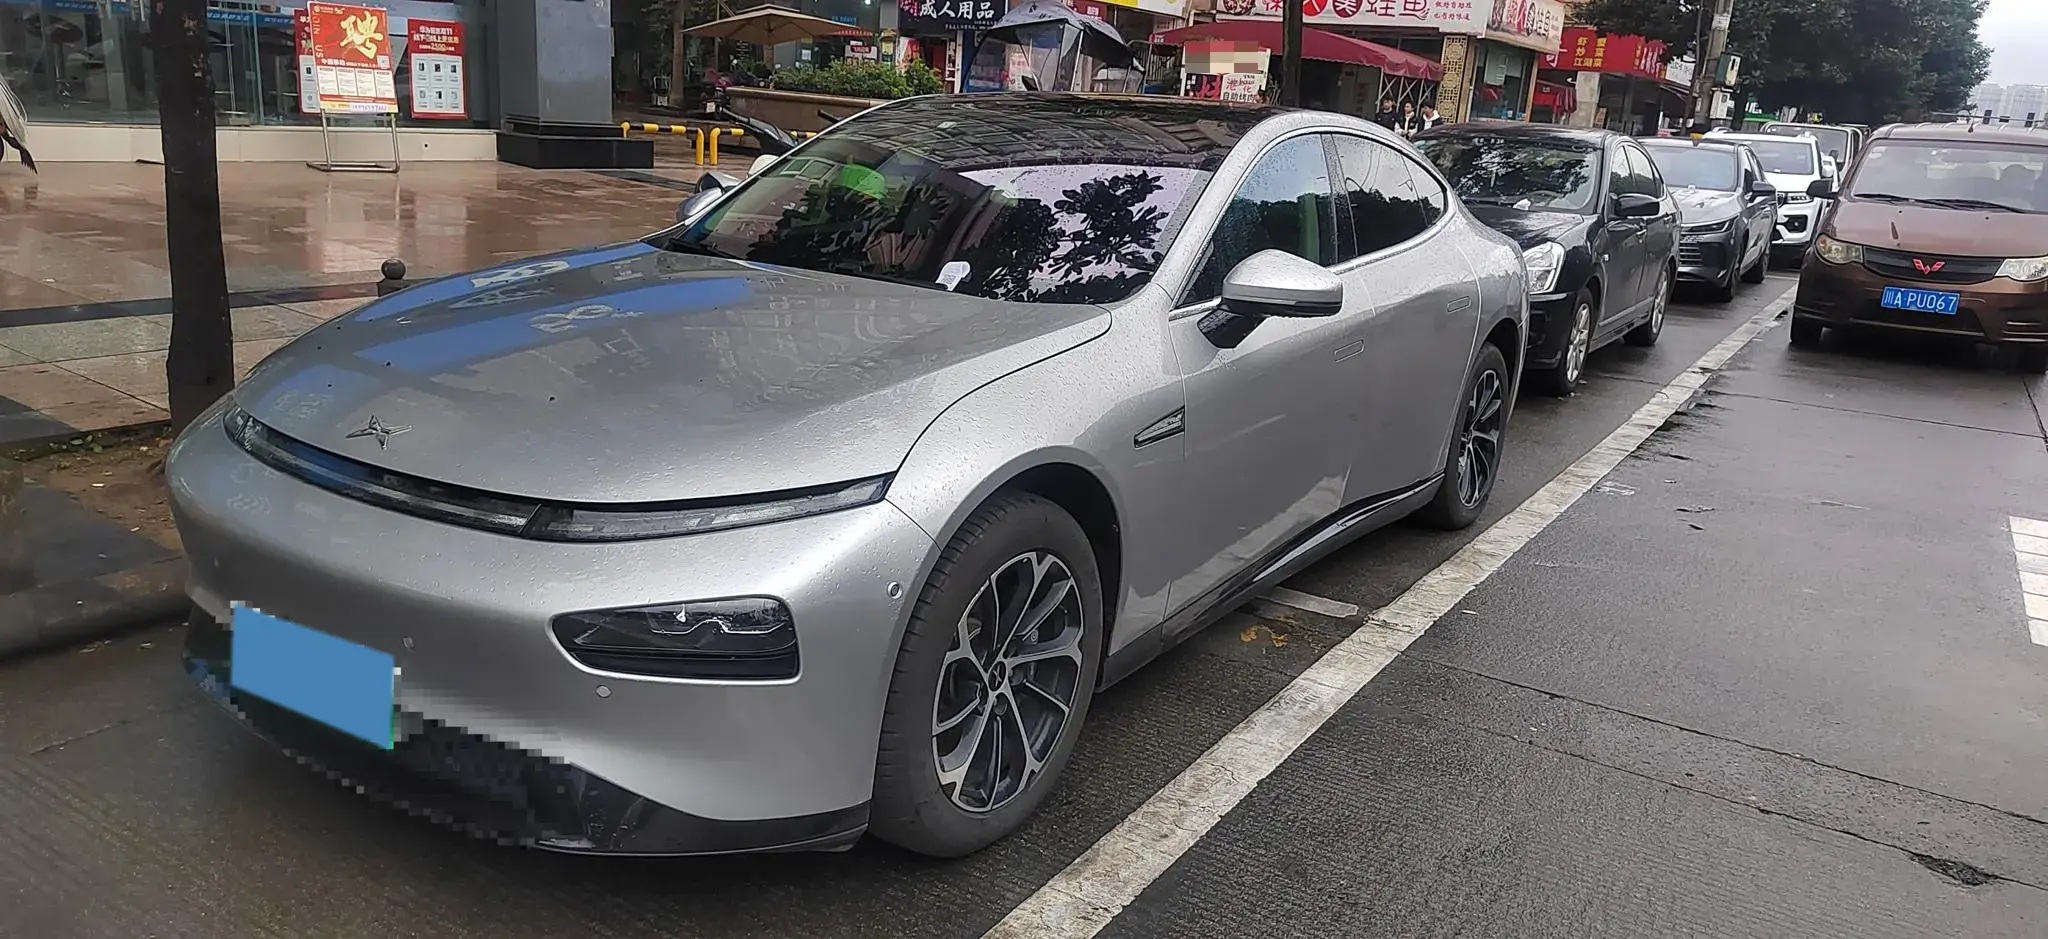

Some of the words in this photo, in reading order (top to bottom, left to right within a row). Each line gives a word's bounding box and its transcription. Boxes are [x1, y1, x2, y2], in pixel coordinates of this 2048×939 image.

[920, 0, 995, 19] 成人用品
[340, 10, 384, 59] 聘
[315, 44, 324, 58] US
